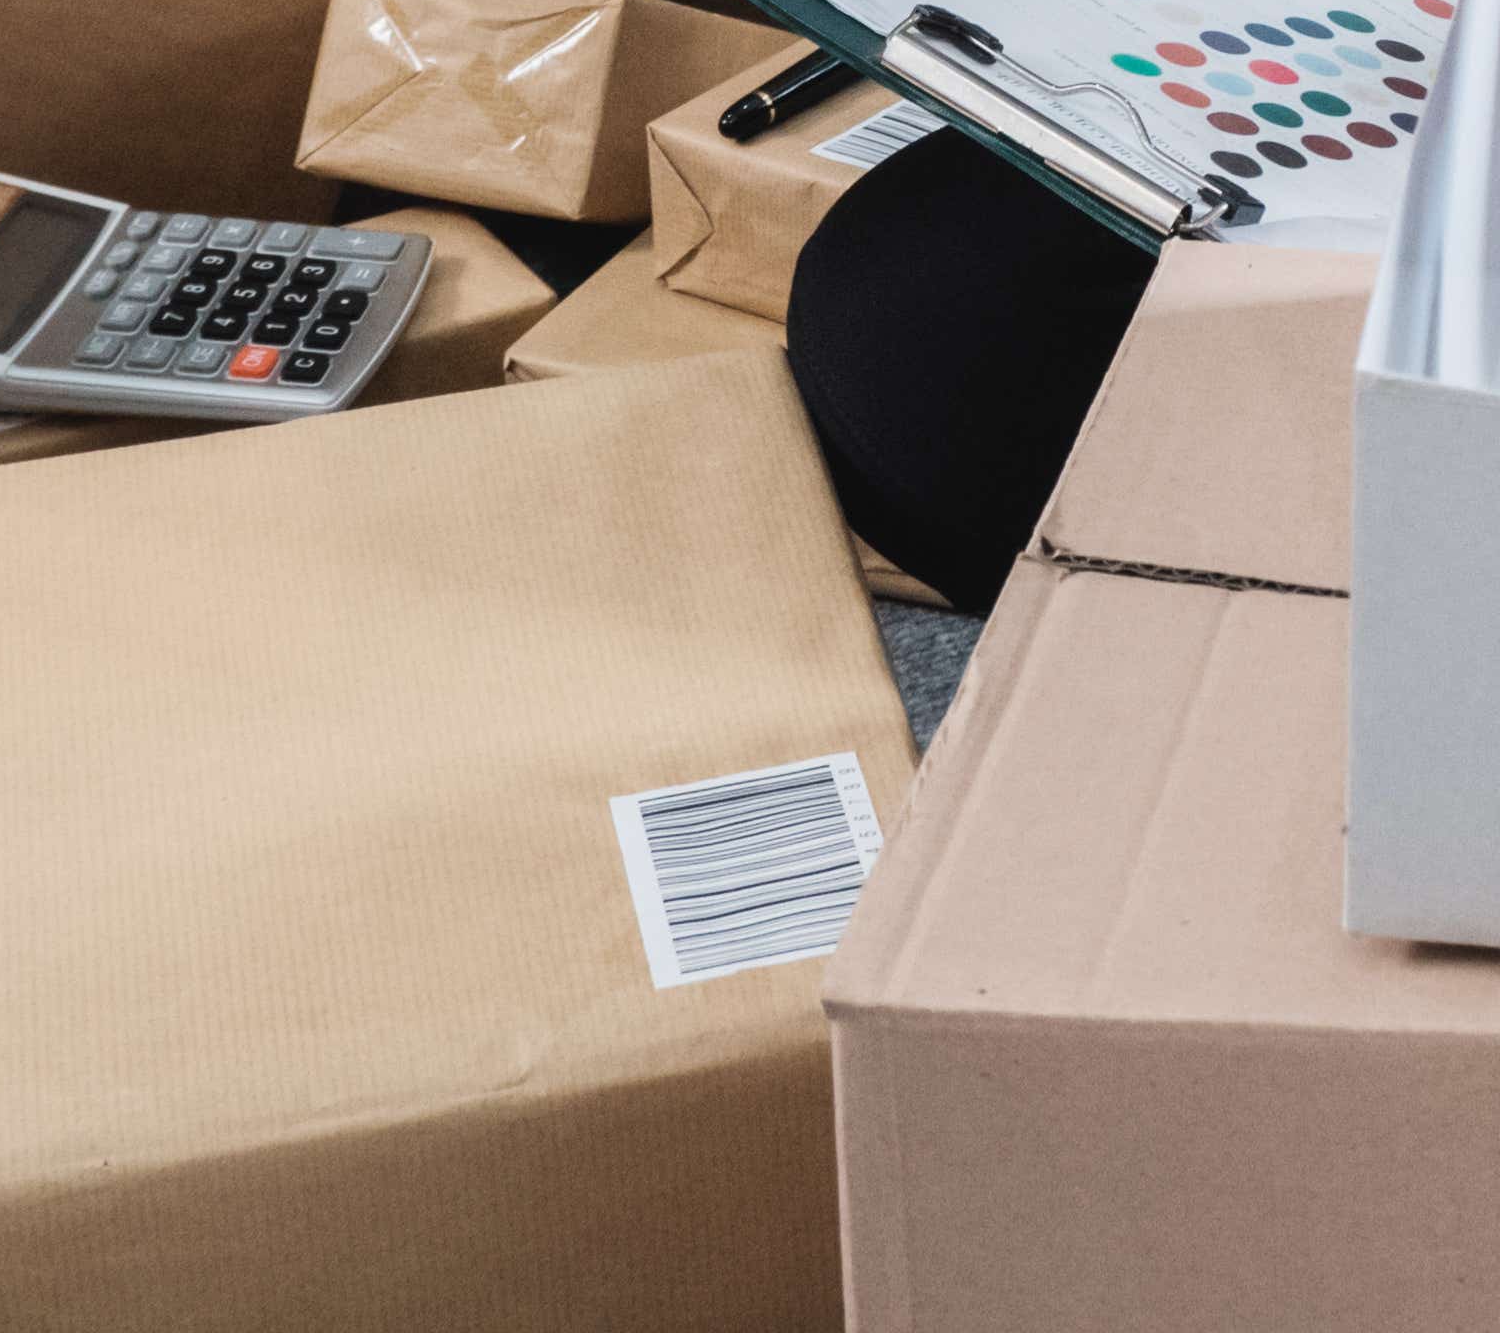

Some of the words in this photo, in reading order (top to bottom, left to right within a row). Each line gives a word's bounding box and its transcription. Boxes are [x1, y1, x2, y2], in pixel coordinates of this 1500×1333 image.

[161, 311, 185, 322] 7
[182, 283, 206, 294] 8
[201, 254, 225, 266] 9
[213, 316, 236, 327] 4
[232, 288, 258, 299] 5
[251, 260, 275, 270] 6
[242, 348, 268, 366] ON
[265, 322, 287, 330] 1
[283, 292, 309, 303] 2
[301, 265, 326, 275] 3
[294, 357, 316, 368] C
[315, 325, 340, 336] 0
